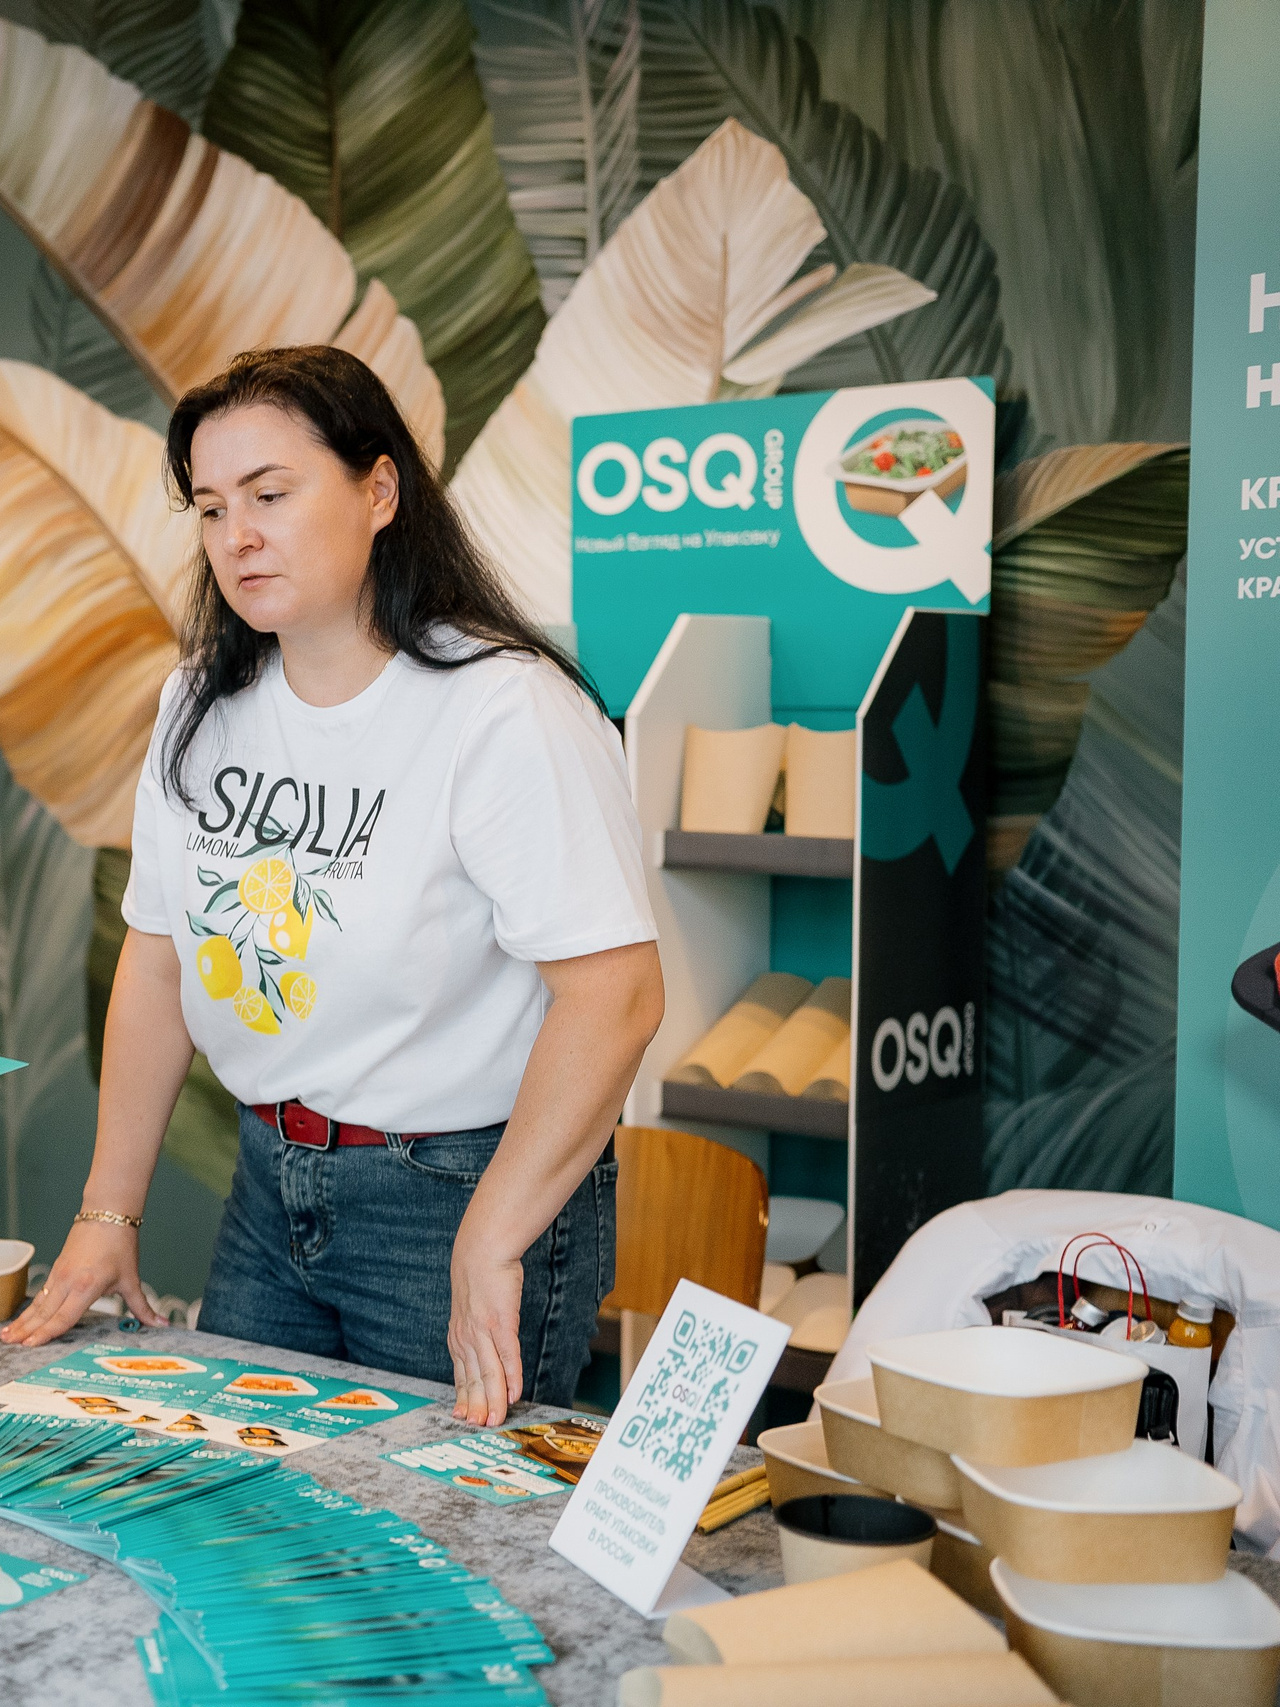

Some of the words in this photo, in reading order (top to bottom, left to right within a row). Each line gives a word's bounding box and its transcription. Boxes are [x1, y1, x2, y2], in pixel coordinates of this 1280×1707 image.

[577, 433, 758, 516] OSQ
[763, 428, 784, 510] GROUP
[1239, 536, 1280, 561] УС
[198, 766, 387, 858] SICILIA
[186, 832, 240, 860] LIMONI
[323, 860, 364, 880] FRUTTA
[871, 1005, 962, 1092] OSQ
[672, 1384, 697, 1408] OSQ
[594, 1480, 666, 1536] ПРОИЗВОДИТЕЛЬ
[612, 1465, 671, 1511] КРУПНЕЙШИЙ
[583, 1498, 613, 1525] КРАФТ
[609, 1516, 658, 1558] УПАКОВКИ
[587, 1527, 597, 1542] В
[595, 1533, 635, 1568] РОССИИ
